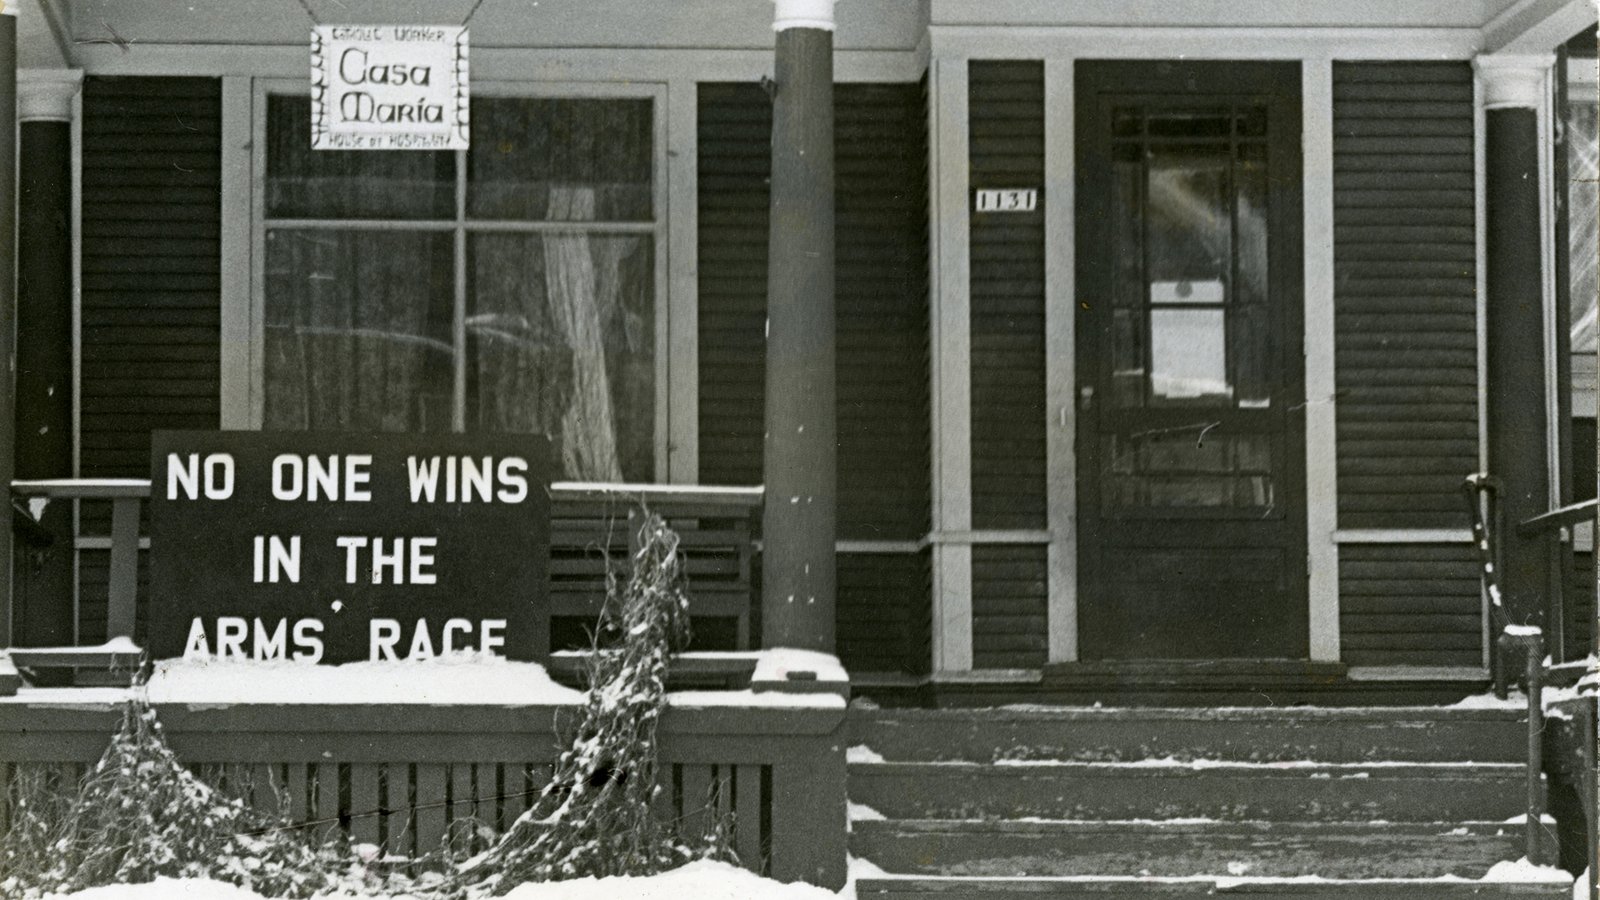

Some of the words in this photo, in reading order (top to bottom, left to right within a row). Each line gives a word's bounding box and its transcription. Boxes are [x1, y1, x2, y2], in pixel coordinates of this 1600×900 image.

[339, 47, 431, 86] Casa
[981, 191, 1031, 209] 1131
[167, 453, 235, 500] NO
[272, 453, 372, 501] ONE
[407, 455, 529, 503] WINS
[253, 535, 301, 583] IN
[336, 536, 438, 584] THE
[183, 617, 324, 664] ARMS
[369, 618, 507, 661] RACE
